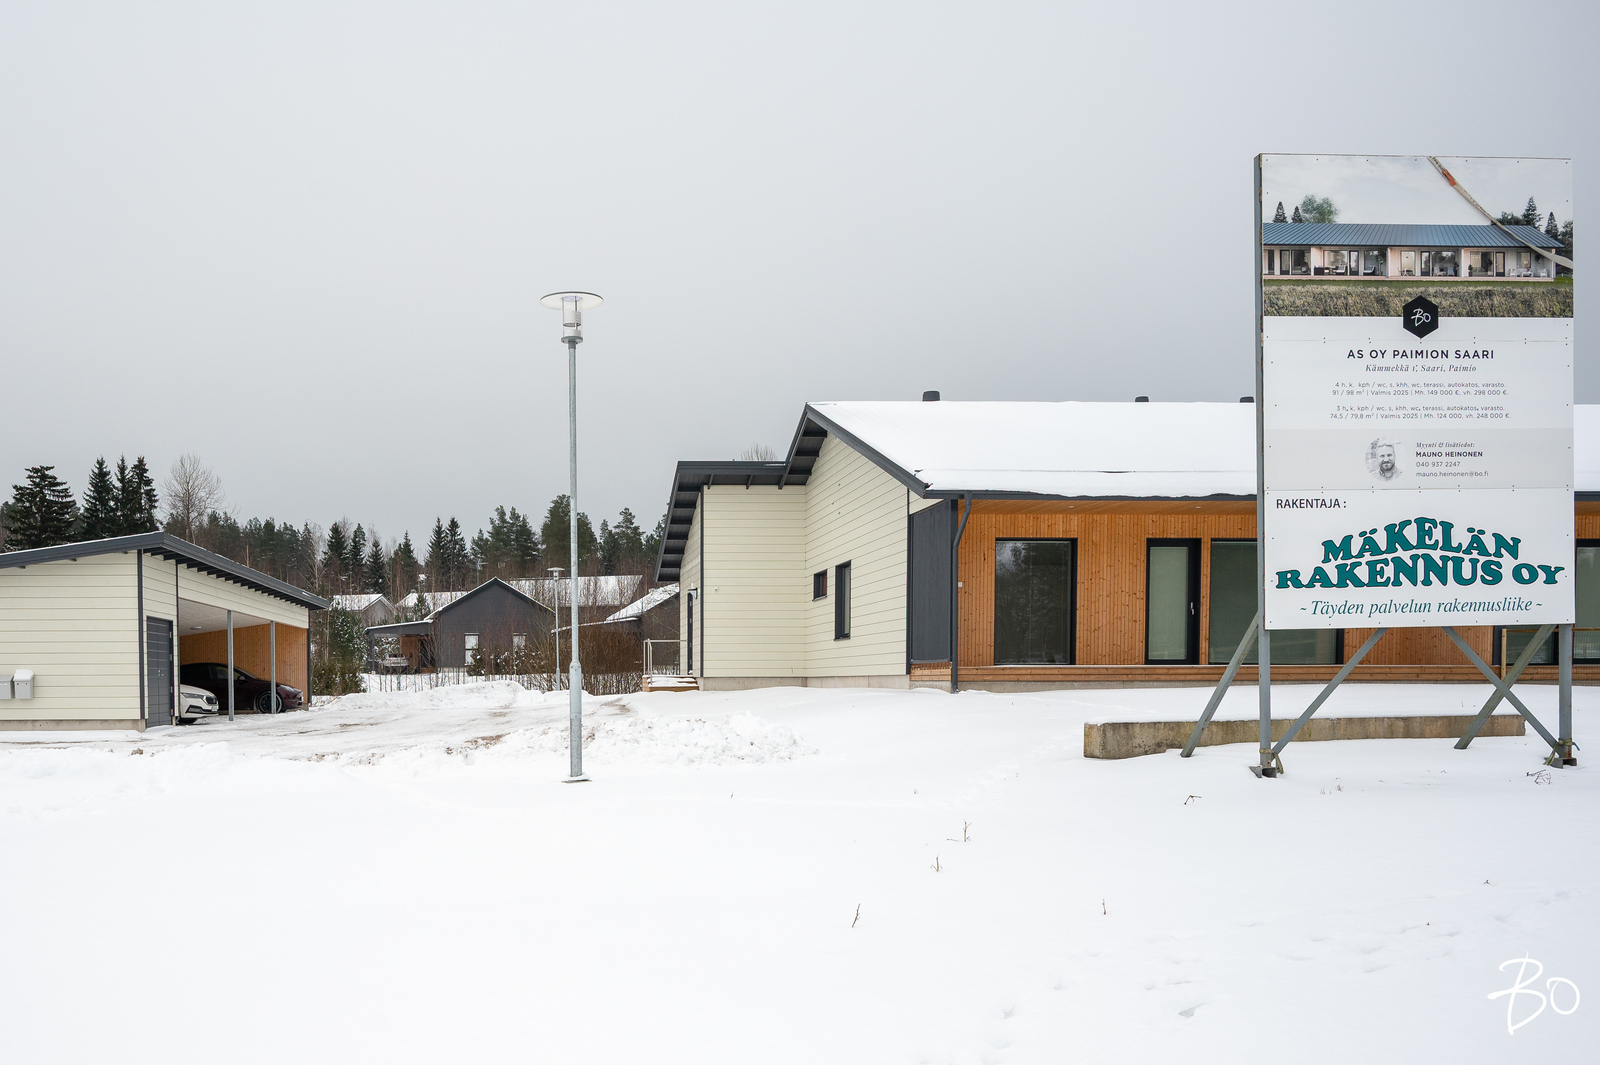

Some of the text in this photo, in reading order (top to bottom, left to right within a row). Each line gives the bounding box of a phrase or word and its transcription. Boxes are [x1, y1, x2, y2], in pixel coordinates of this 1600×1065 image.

[1347, 349, 1494, 359] AS OY PAIMION SAARI
[1365, 364, 1409, 372] Kämmekkä
[1421, 364, 1446, 373] Saari,
[1448, 364, 1477, 372] Paimio
[1415, 470, 1489, 478] mauno.heinonen@bo.fi
[1321, 517, 1521, 563] MÄKELÄN
[1276, 553, 1565, 589] RAKENNUS OY
[1311, 600, 1364, 619] Täyden
[1368, 598, 1432, 618] palvelun
[1437, 597, 1532, 613] rakennusliike
